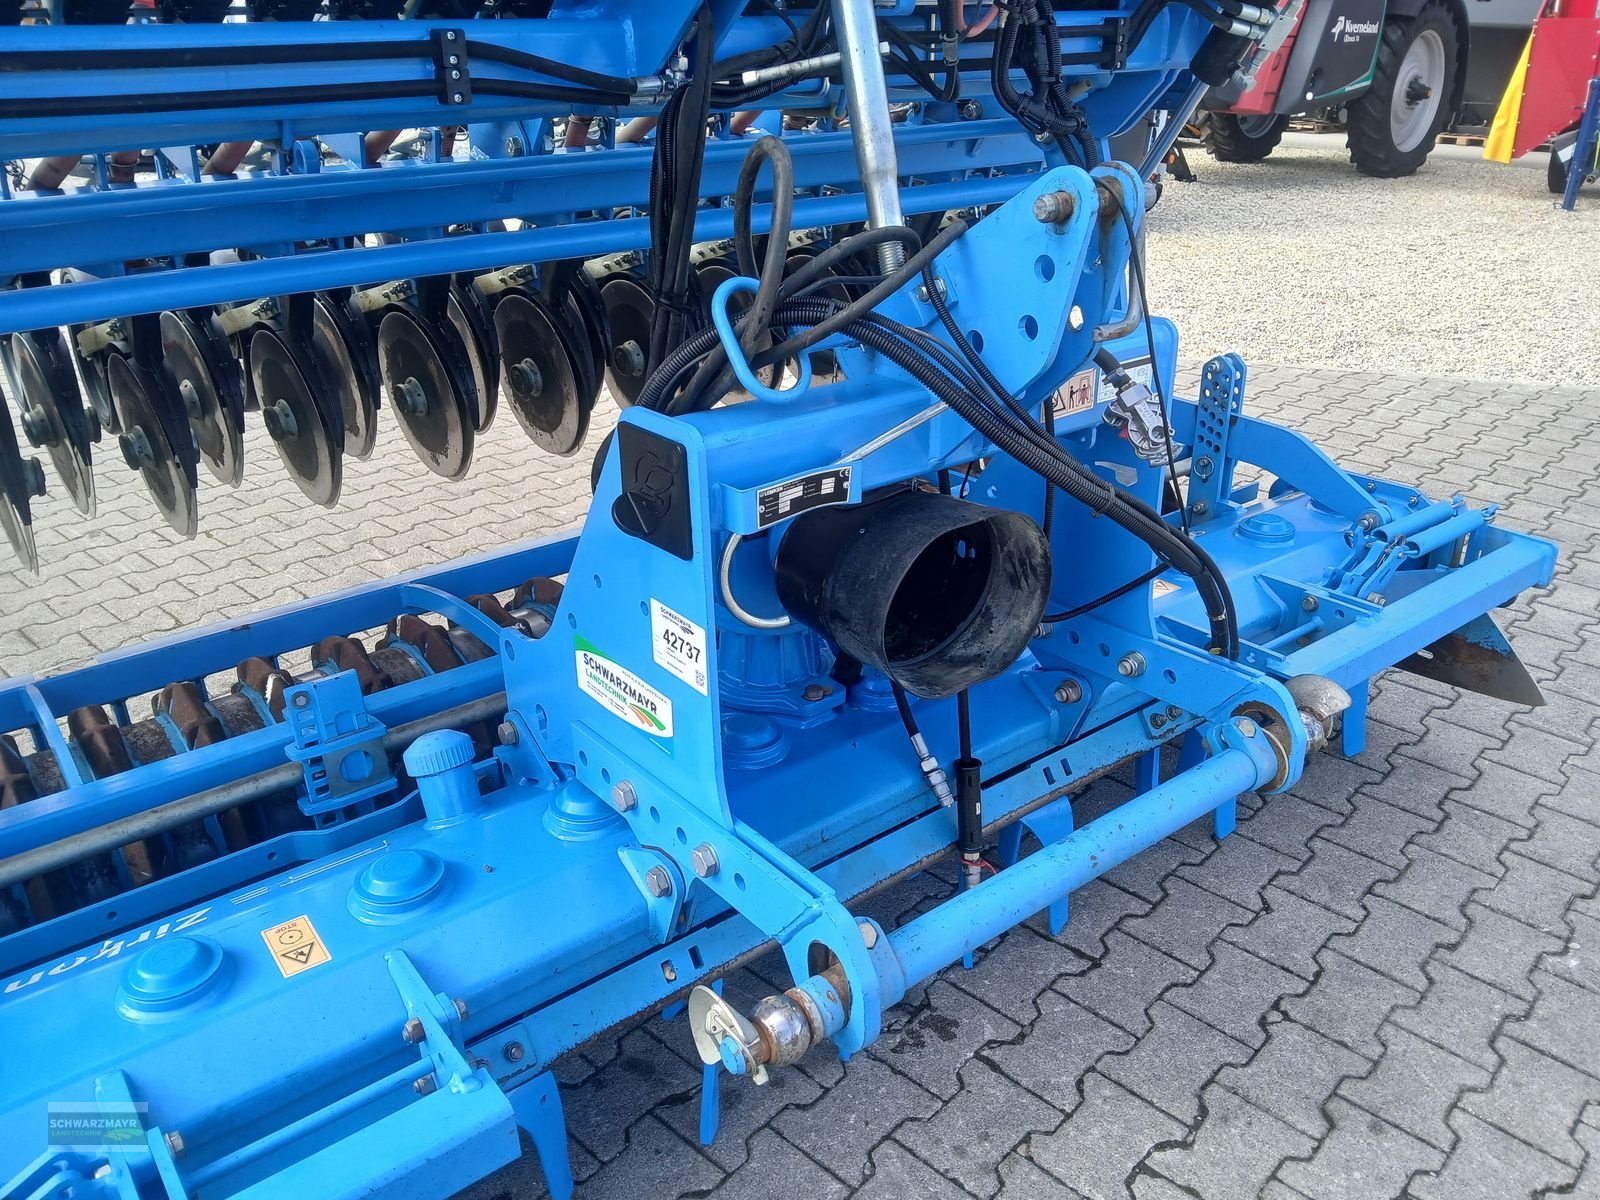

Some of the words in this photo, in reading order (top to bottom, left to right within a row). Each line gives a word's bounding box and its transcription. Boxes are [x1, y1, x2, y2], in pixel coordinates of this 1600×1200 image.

[663, 629, 700, 663] 42737
[583, 653, 657, 715] SCHWARZMAYR
[585, 668, 628, 705] LANDTECHNIK
[275, 922, 297, 934] STOP
[4, 906, 213, 993] zirkon
